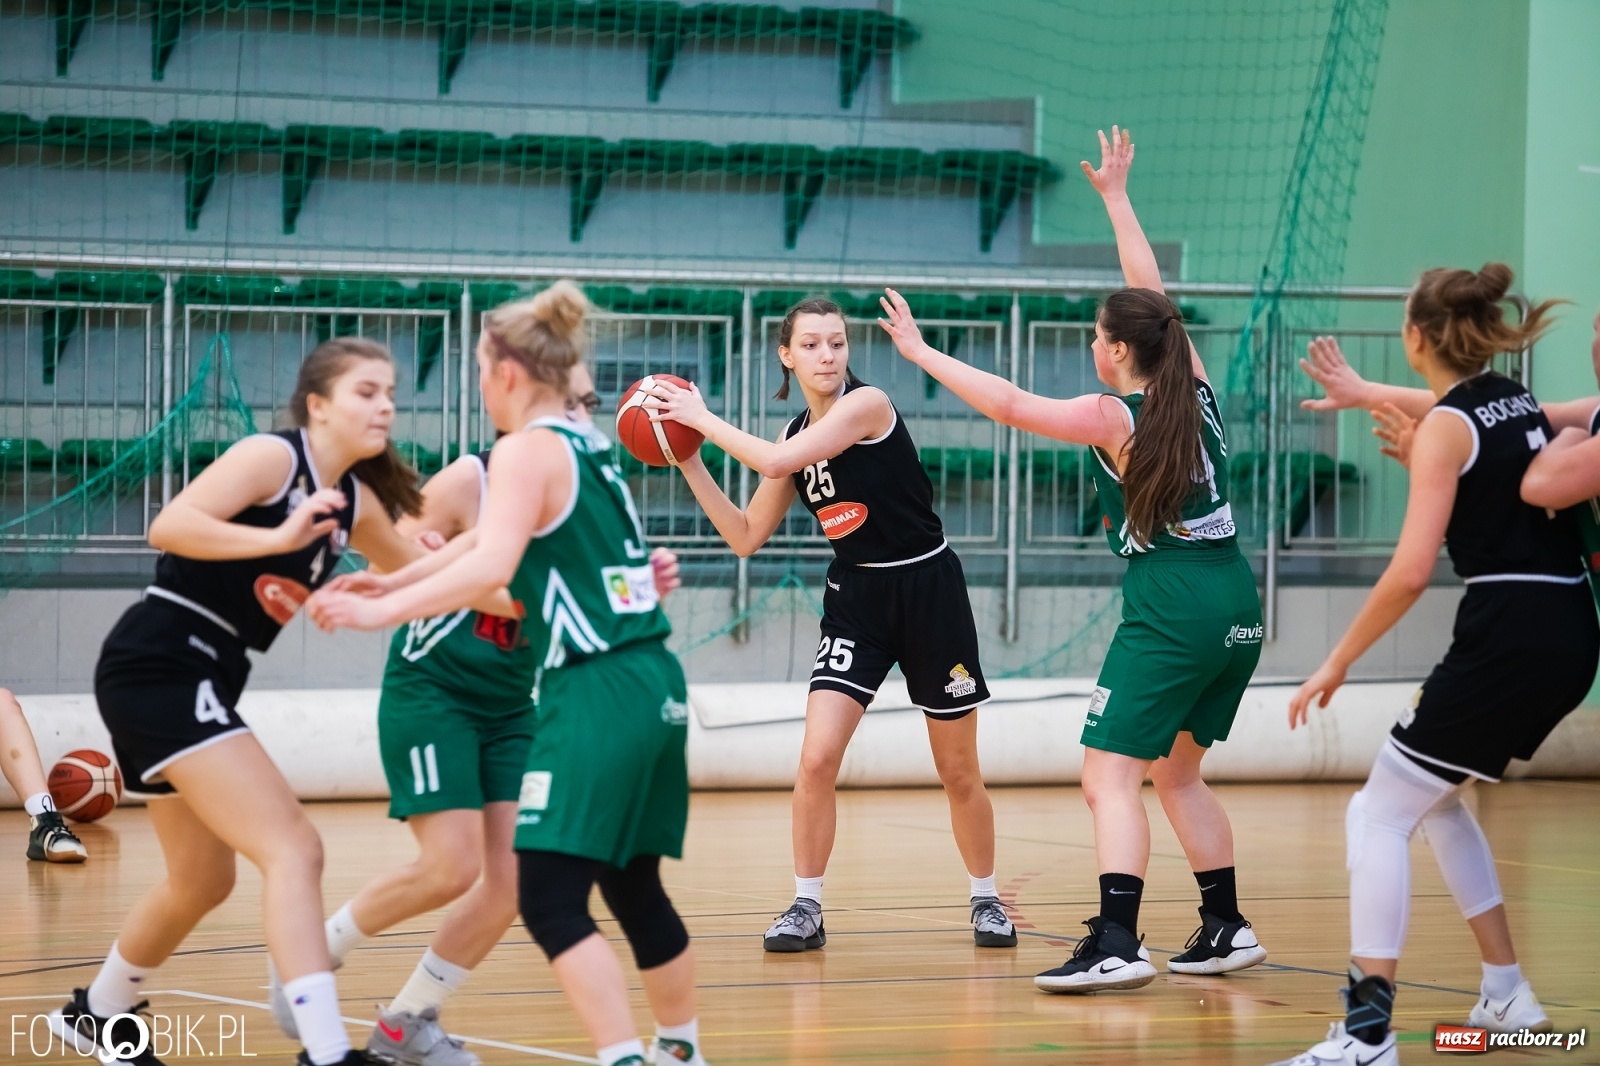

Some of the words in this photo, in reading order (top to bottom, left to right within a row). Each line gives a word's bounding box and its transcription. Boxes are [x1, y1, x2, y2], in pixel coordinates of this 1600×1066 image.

[804, 459, 835, 503] 25
[821, 508, 859, 529] ONTIMAX
[814, 636, 855, 672] 25
[195, 678, 230, 725] 4
[954, 688, 975, 697] KING
[409, 743, 440, 795] 11
